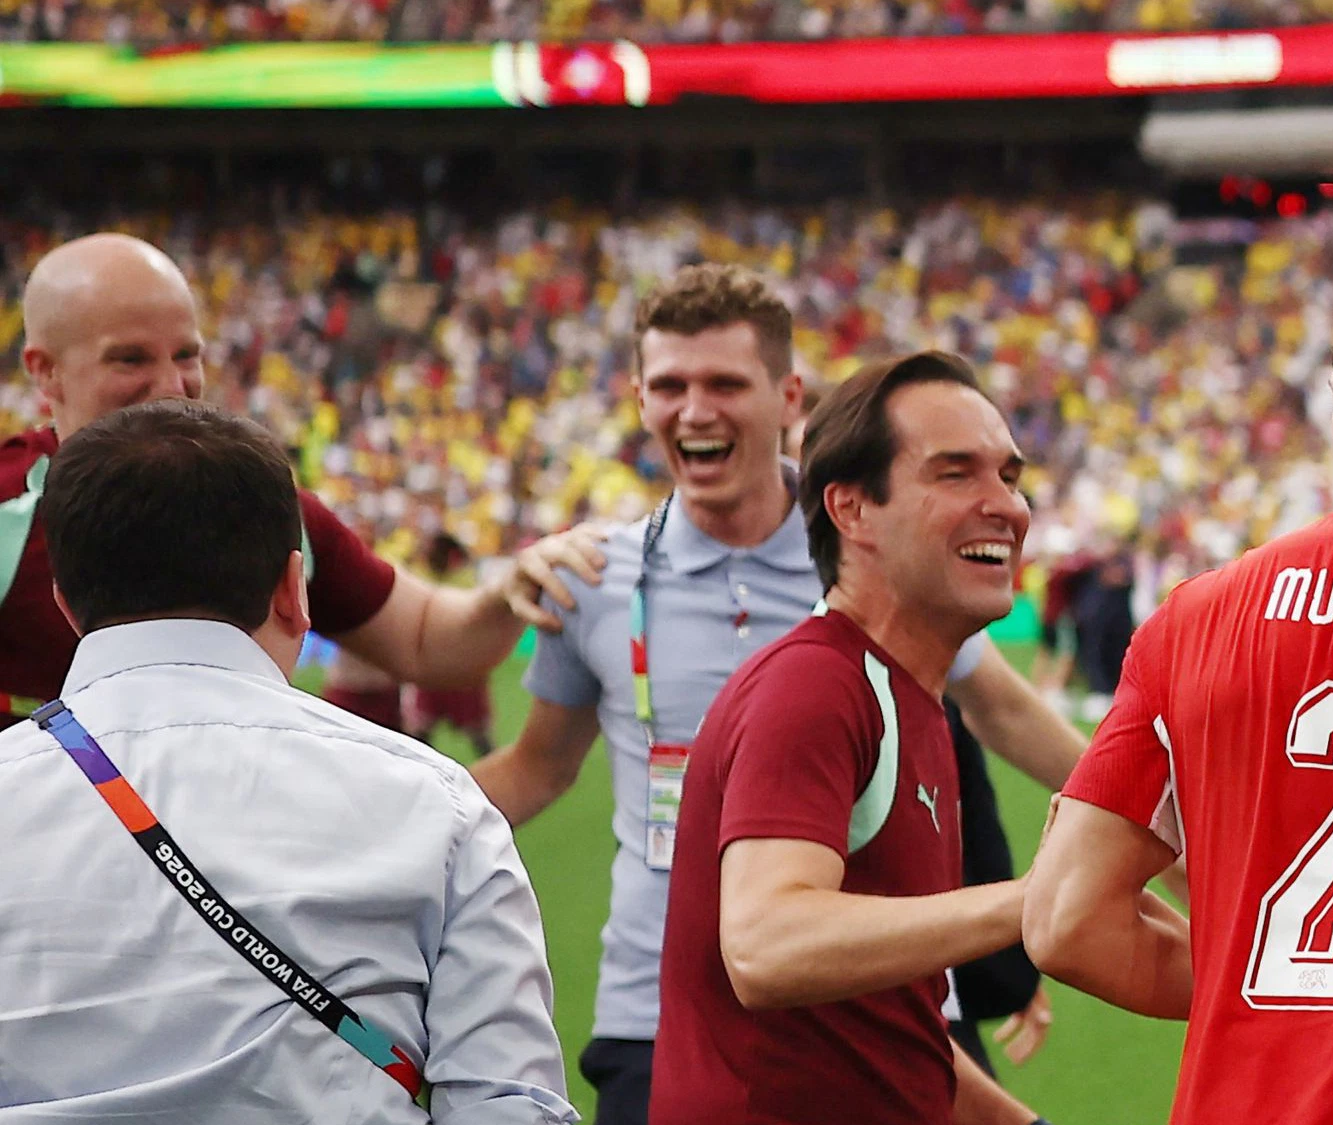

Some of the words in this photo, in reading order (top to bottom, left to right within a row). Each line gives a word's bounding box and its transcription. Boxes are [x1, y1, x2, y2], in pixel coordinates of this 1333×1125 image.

[200, 898, 235, 930] CUP
[231, 926, 294, 984] WORLD
[291, 975, 331, 1012] FIFA
